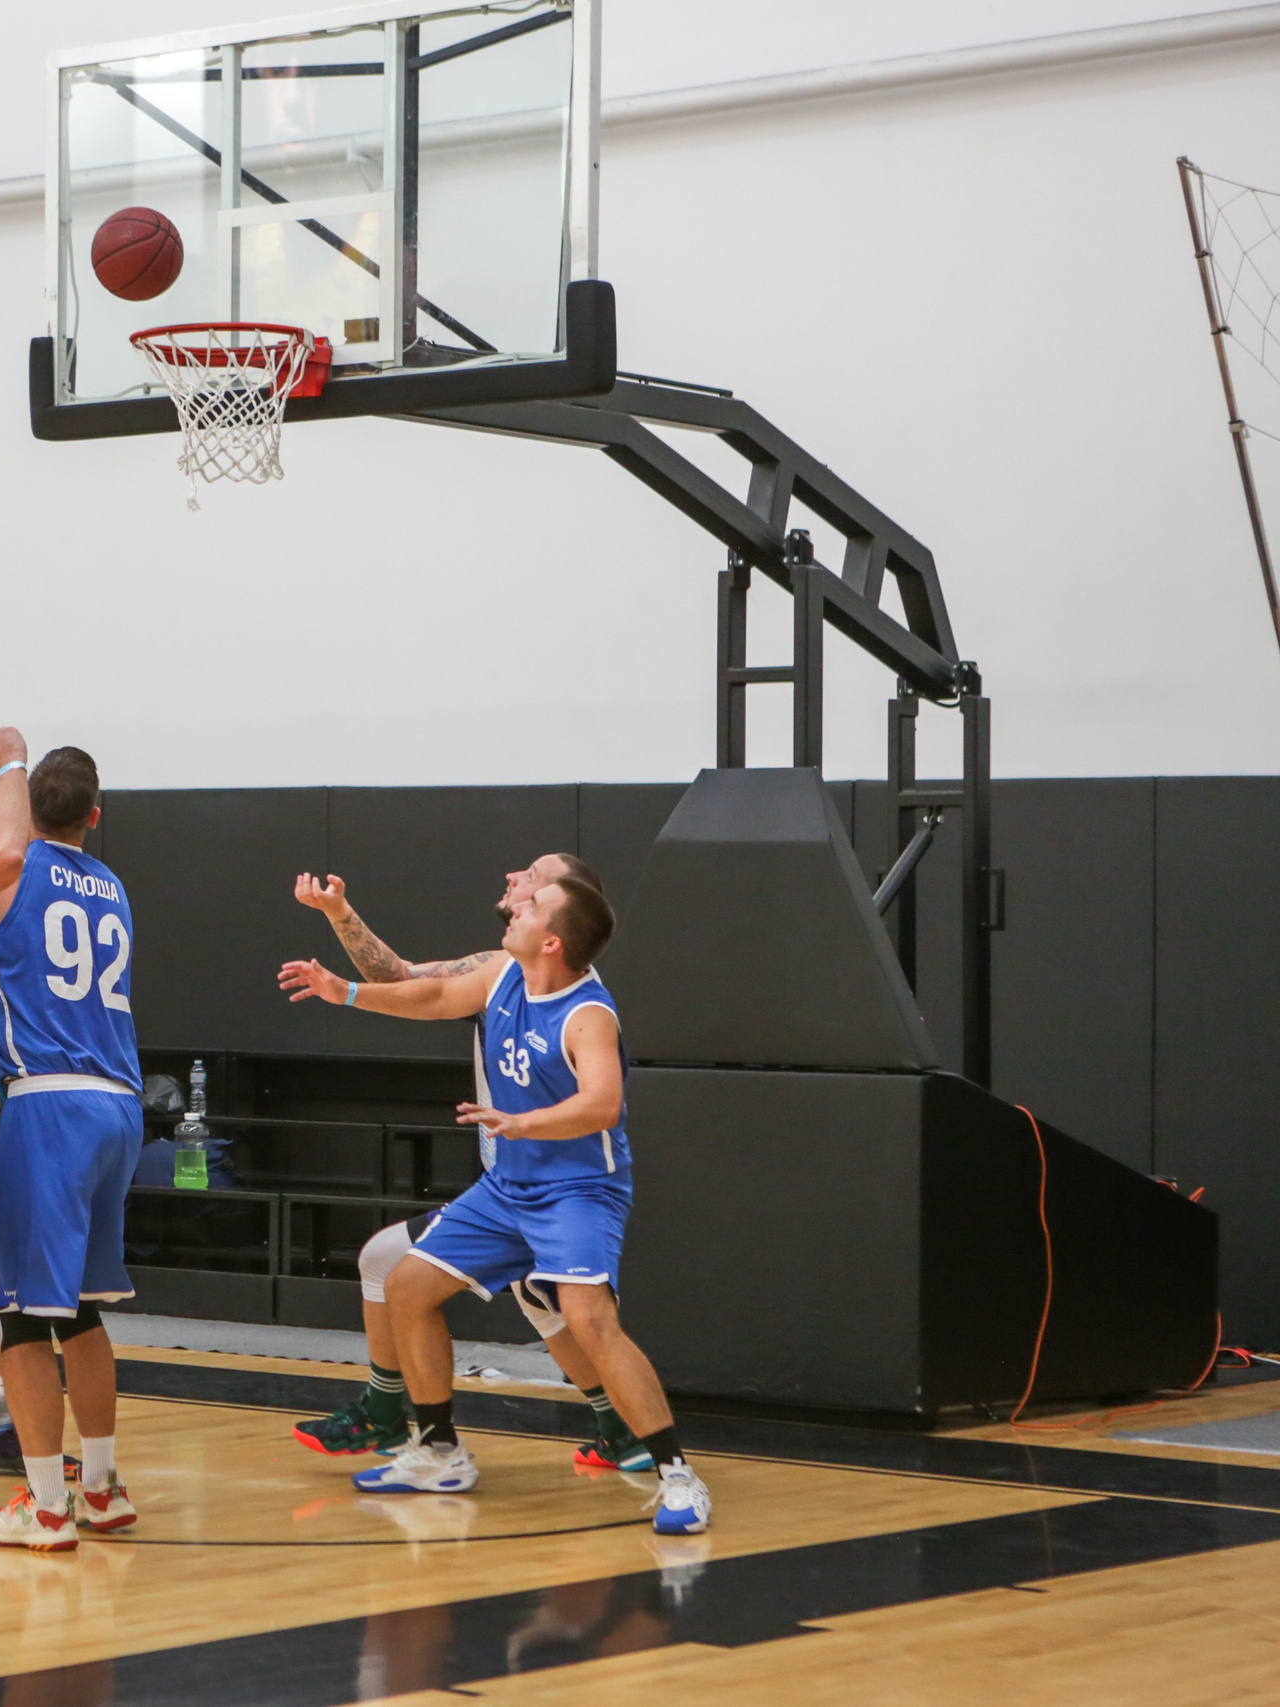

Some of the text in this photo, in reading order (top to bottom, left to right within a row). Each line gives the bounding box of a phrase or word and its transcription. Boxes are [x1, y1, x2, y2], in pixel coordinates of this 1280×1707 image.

[50, 865, 120, 903] СУДОША
[44, 900, 132, 1014] 92
[498, 1037, 531, 1087] 33
